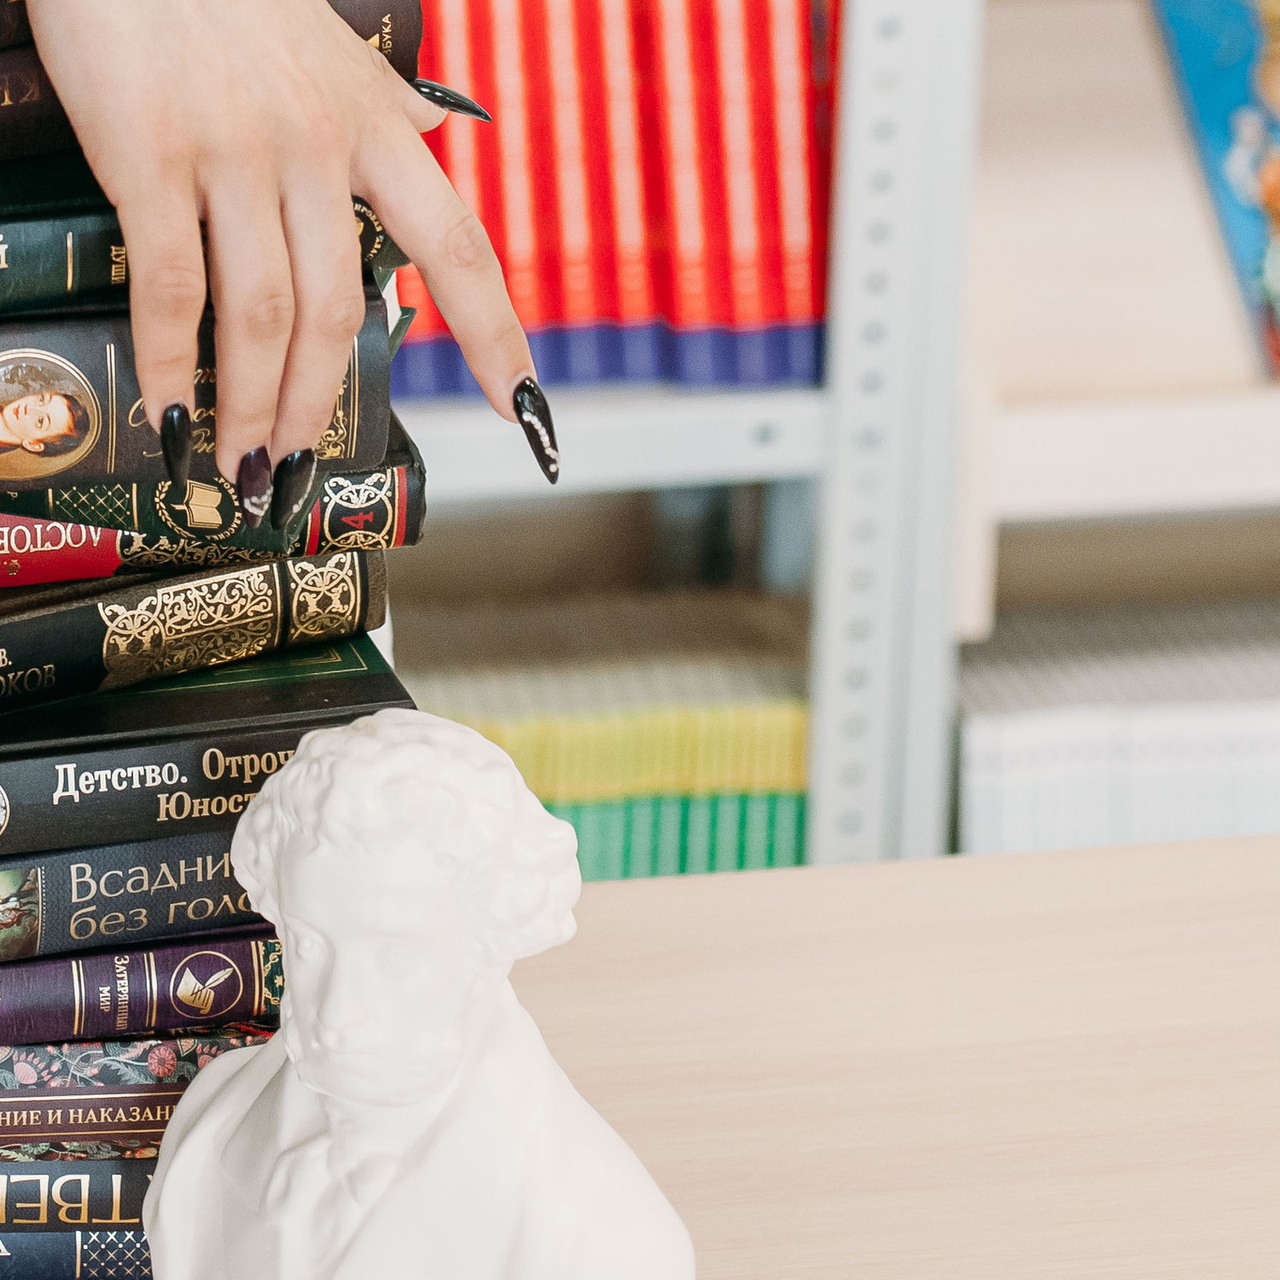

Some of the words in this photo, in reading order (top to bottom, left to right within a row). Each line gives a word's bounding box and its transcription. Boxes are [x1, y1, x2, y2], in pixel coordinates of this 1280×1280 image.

[380, 13, 393, 56] ЗБУКА
[53, 762, 188, 805] Детство.
[202, 748, 295, 784] Отроч
[69, 852, 231, 903] Всадни
[70, 905, 148, 940] без
[98, 986, 111, 1013] МИР
[47, 1109, 63, 1125] И
[68, 1104, 177, 1125] НАКАЗАН
